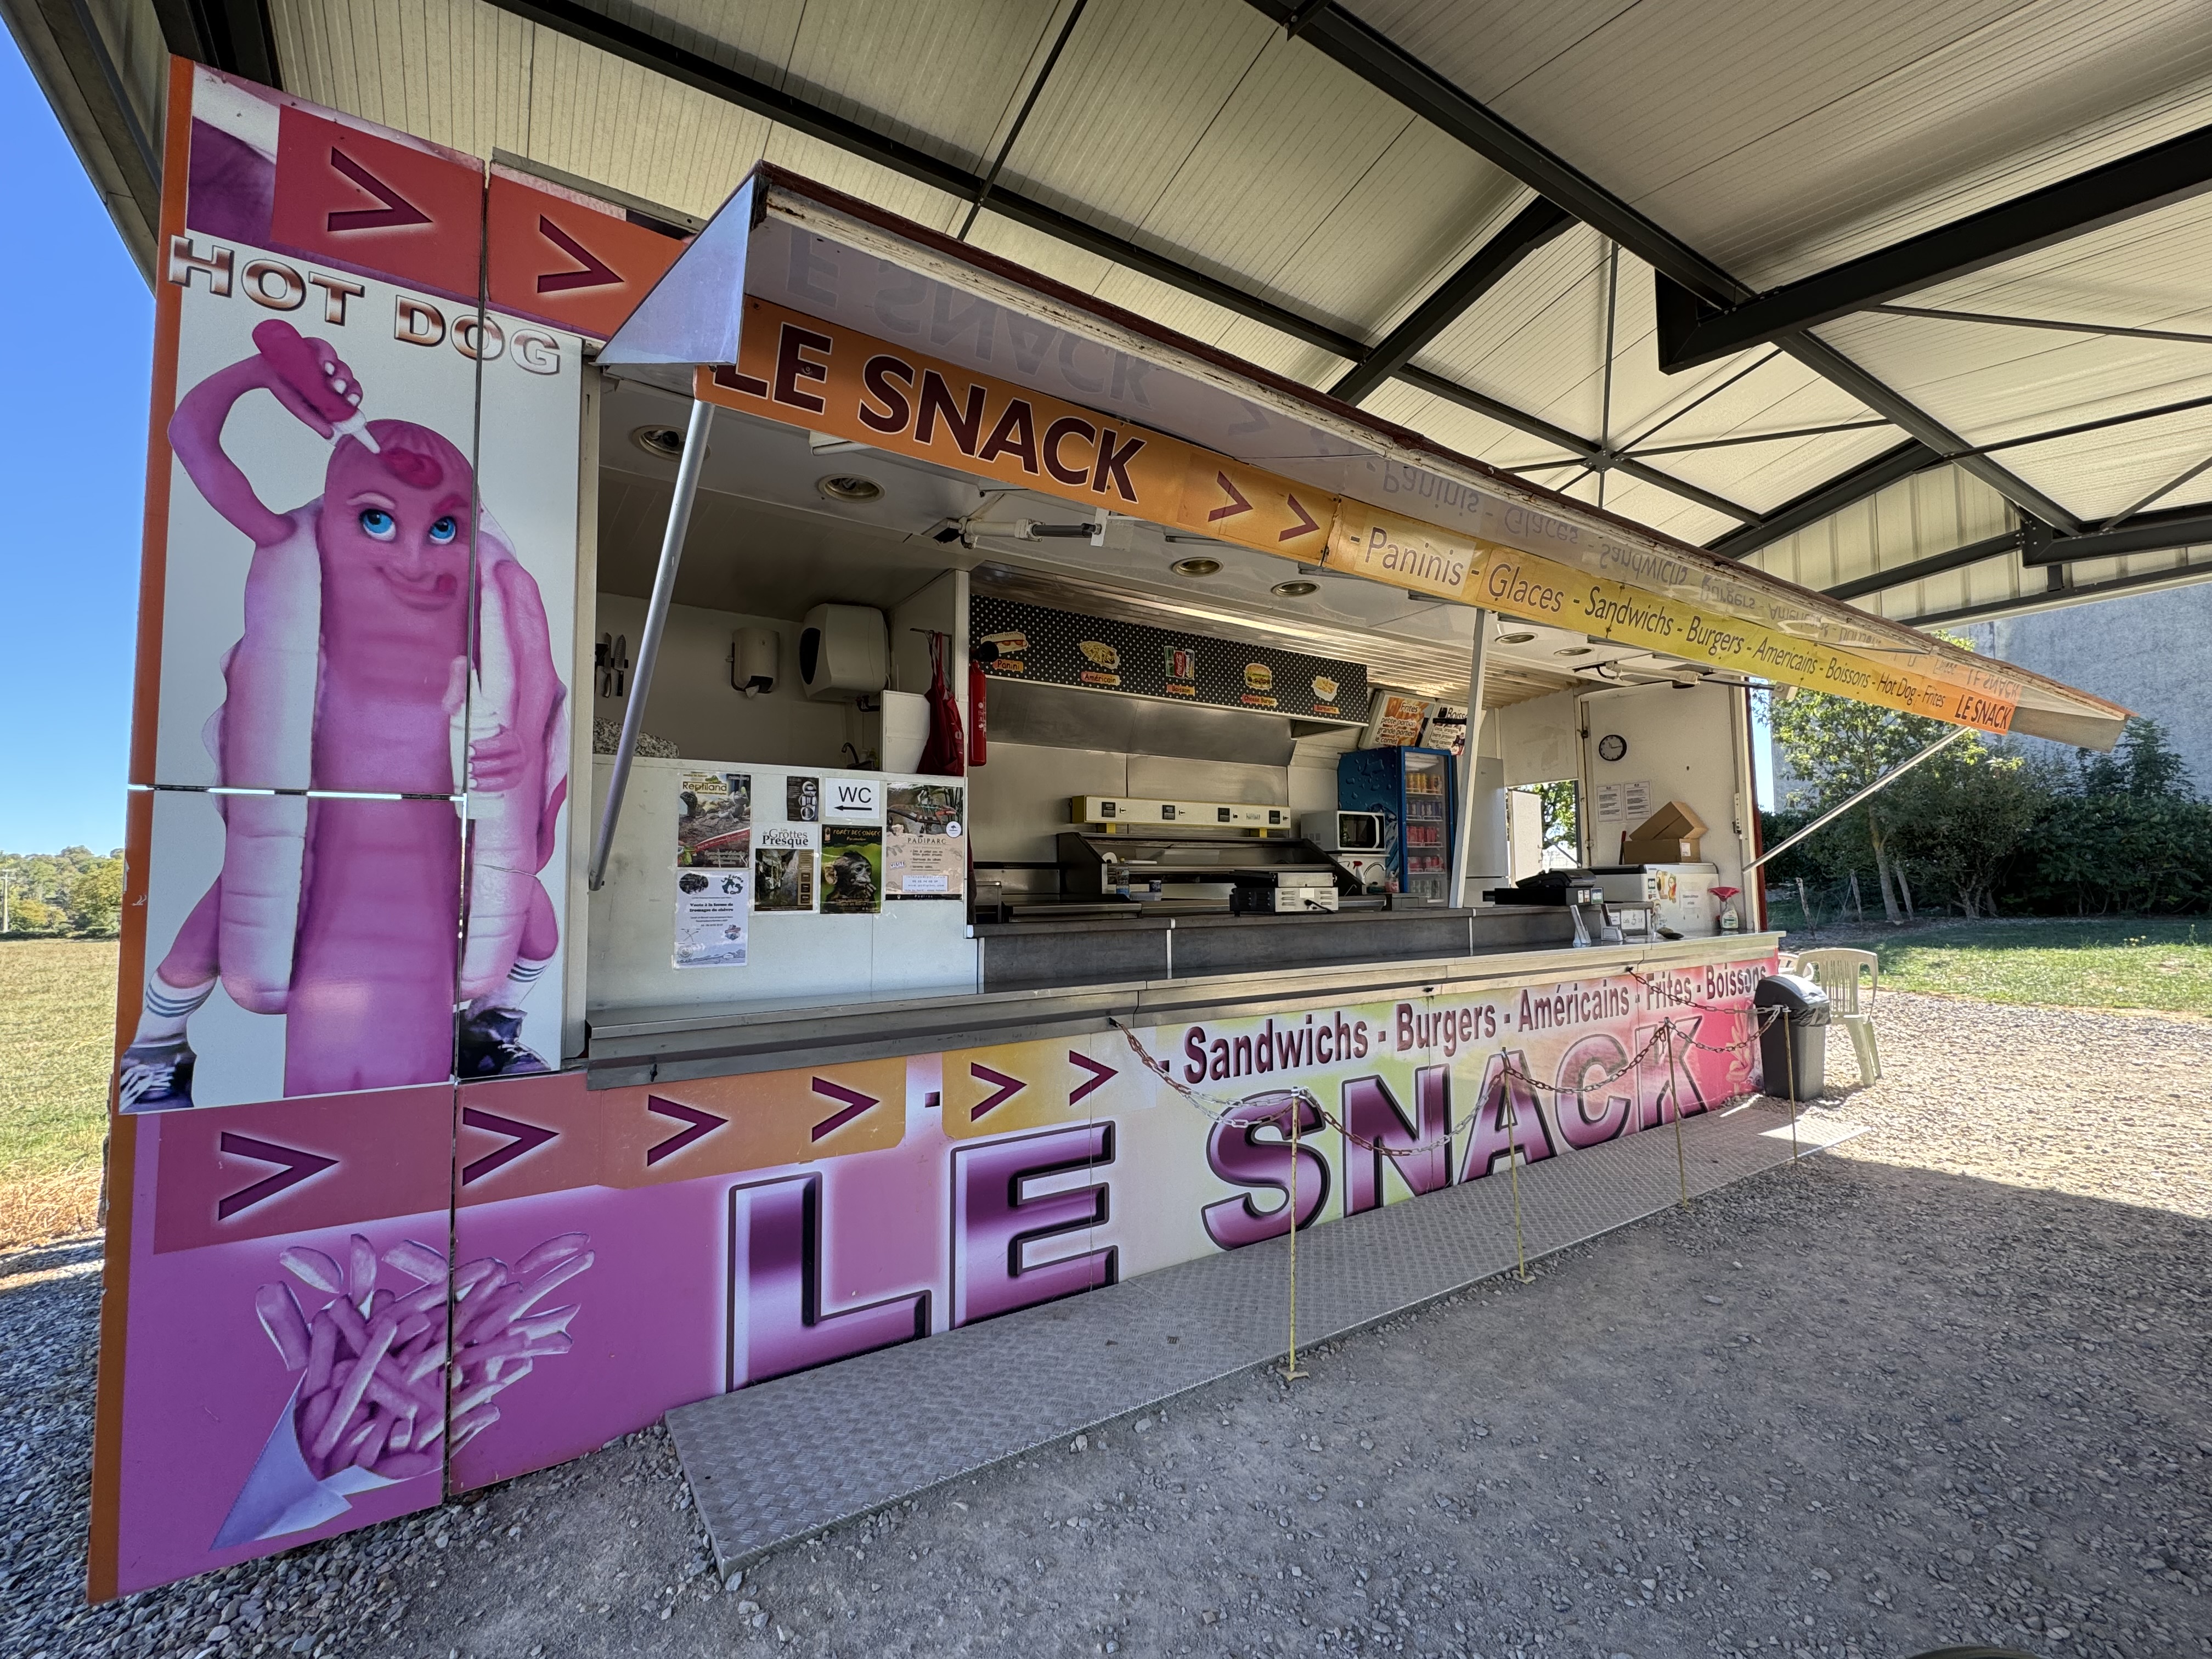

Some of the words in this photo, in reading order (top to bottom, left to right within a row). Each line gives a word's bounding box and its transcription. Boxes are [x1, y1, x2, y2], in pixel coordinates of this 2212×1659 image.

[168, 234, 364, 326] HOT
[394, 295, 561, 375] DOG
[857, 354, 1147, 504] SNACK
[1365, 527, 1464, 586] Paninis
[1488, 563, 1565, 613] Glaces
[1585, 586, 1674, 636] Sandwichs
[1686, 616, 1745, 656] Burgers
[1755, 637, 1817, 675] Americains
[1825, 657, 1871, 689] Boissons
[1877, 672, 1897, 696] Hot
[1896, 678, 1918, 706] Dog
[1922, 685, 1946, 708] Frites
[1954, 693, 1974, 720] LE
[1971, 699, 2014, 730] SNACK
[1084, 673, 1116, 684] Américain
[1261, 697, 1276, 705] Burger
[1400, 702, 1419, 713] Frites
[1380, 716, 1397, 725] petite
[1396, 729, 1415, 737] portion
[683, 781, 727, 792] Reptiland
[838, 786, 872, 804] WC
[769, 828, 808, 839] Grottes
[762, 835, 809, 848] Presque
[1183, 1011, 1368, 1085] Sandwichs
[1396, 1002, 1497, 1058] Burgers
[1517, 979, 1630, 1032] Américains
[1646, 972, 1692, 1011] Frites
[1706, 965, 1766, 1001] Boissons
[726, 1120, 1119, 1393] LE
[1201, 1016, 1711, 1251] SNACK
